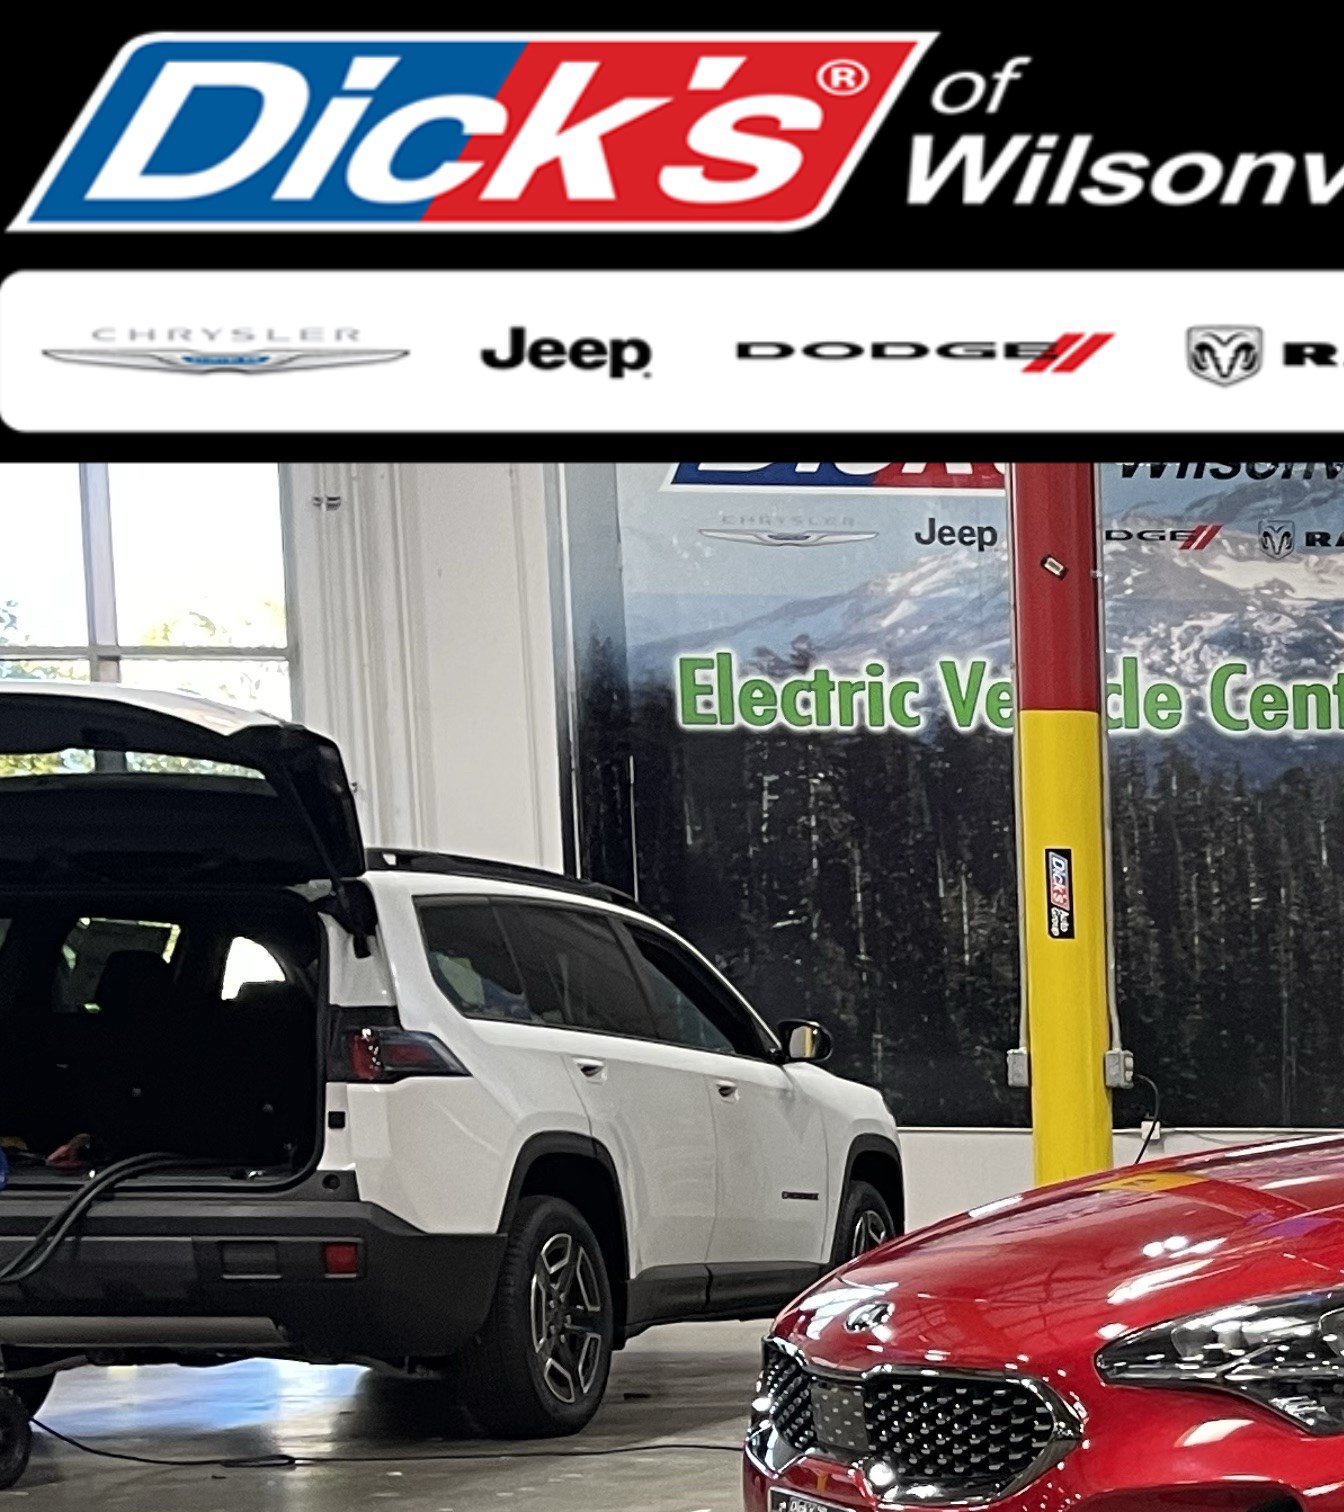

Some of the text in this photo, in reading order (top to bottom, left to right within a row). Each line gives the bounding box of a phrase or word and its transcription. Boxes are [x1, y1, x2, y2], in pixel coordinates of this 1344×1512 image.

[914, 517, 998, 551] Jeep
[1104, 529, 1195, 542] DGE
[679, 652, 920, 727] Electric
[939, 656, 1183, 731] Vecle
